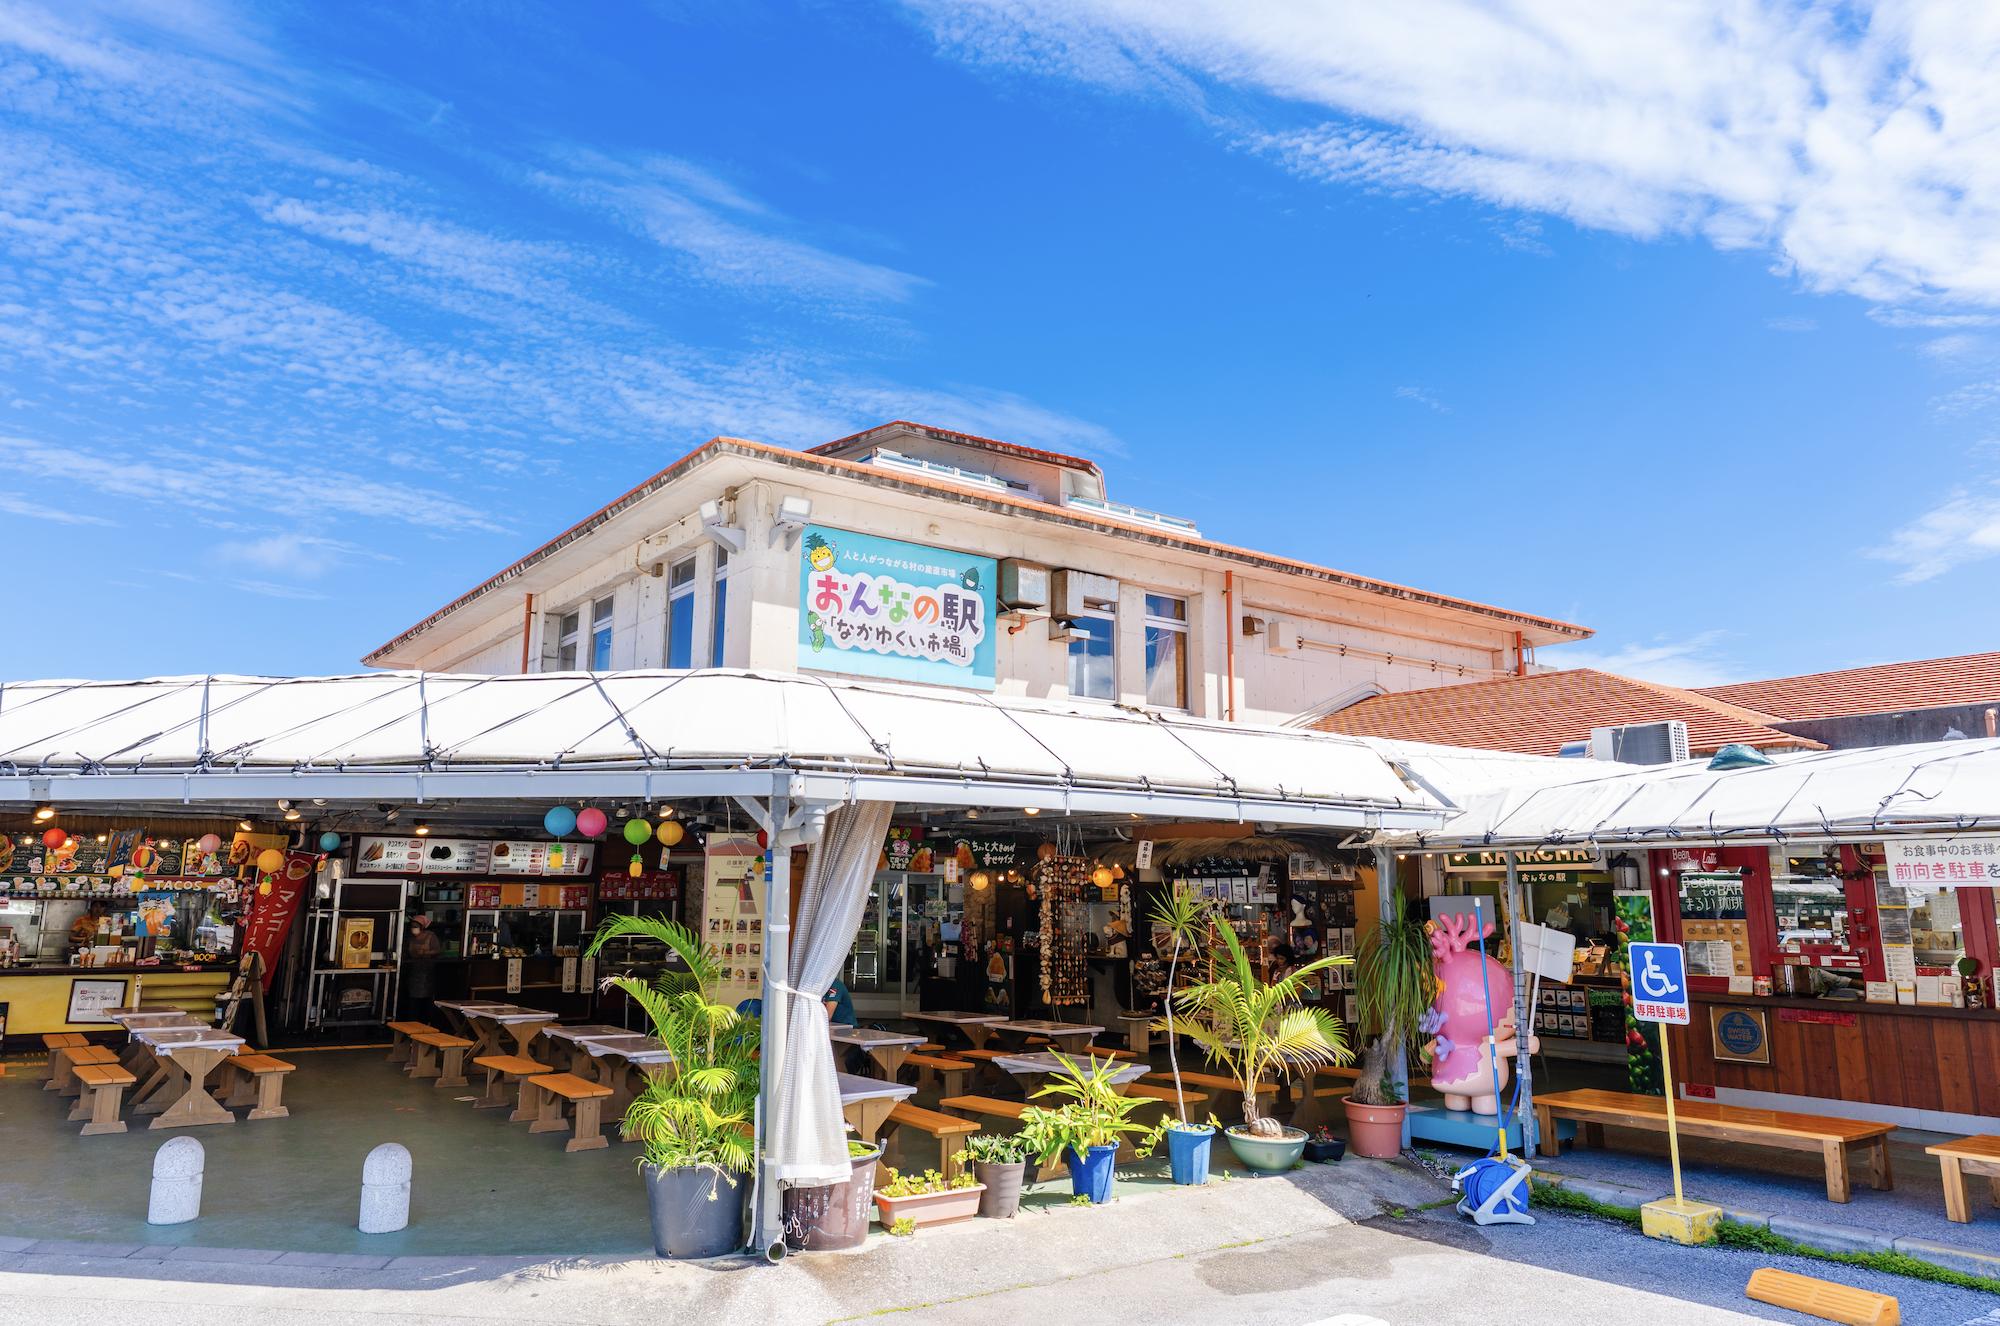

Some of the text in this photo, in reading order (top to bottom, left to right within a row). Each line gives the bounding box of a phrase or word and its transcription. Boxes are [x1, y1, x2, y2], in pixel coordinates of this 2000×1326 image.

[815, 574, 980, 635] おんなの駅
[831, 616, 966, 658] 「なかゆくい市場」
[154, 880, 203, 891] TACOS
[1521, 872, 1567, 883] おんなの駅
[1702, 883, 1744, 897] to BAR
[264, 890, 296, 948] マンゴー
[1636, 1004, 1686, 1021] 専用駐車場
